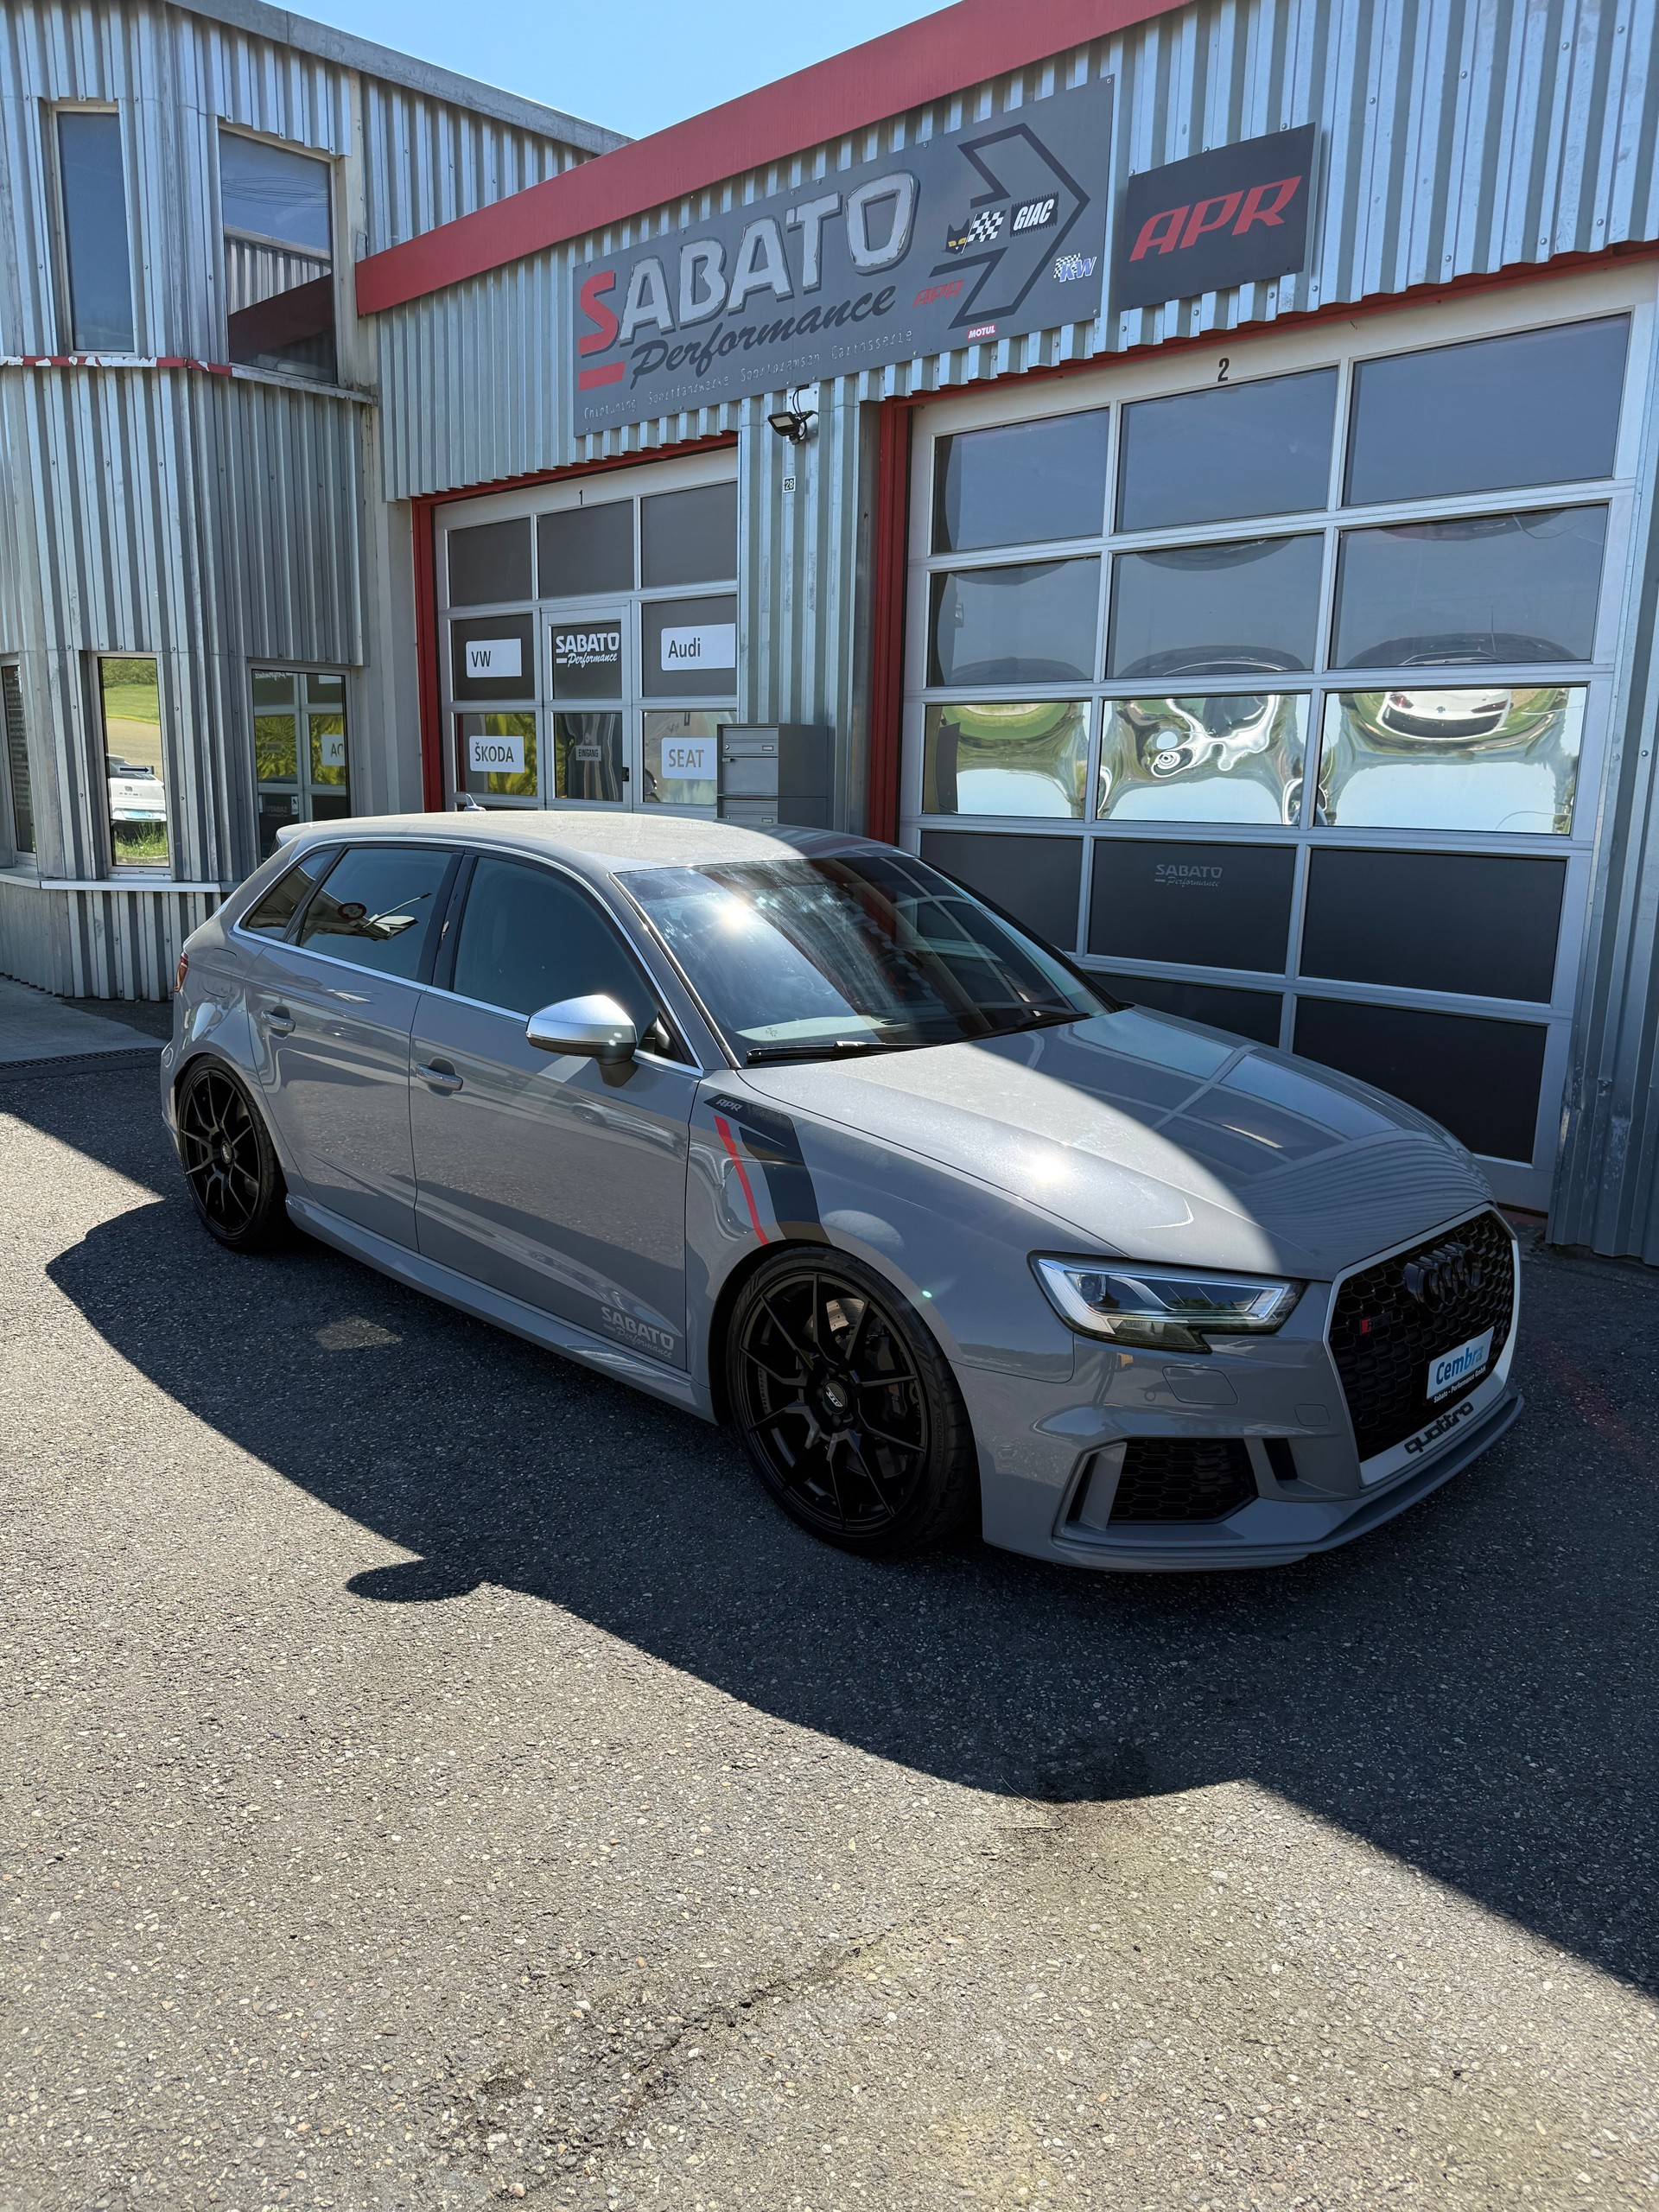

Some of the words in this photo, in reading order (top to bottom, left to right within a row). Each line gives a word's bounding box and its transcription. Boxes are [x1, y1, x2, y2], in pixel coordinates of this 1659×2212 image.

[1013, 199, 1055, 232] GIAC
[1129, 175, 1302, 262] APR
[578, 171, 918, 356] SABATO
[1058, 257, 1096, 283] KW
[912, 279, 963, 307] APR
[630, 285, 896, 390] Performance
[968, 325, 995, 339] MOTUL
[1217, 358, 1230, 381] 2
[785, 480, 793, 490] 28
[578, 489, 584, 505] 1
[556, 632, 620, 653] SABATO
[668, 638, 701, 658] Audi
[471, 651, 492, 667] VW
[568, 652, 618, 668] Performance
[475, 741, 514, 762] ŠKODA
[578, 748, 599, 757] EINGANG
[668, 749, 705, 768] SEAT
[1155, 864, 1223, 878] SABATO
[1166, 875, 1220, 887] Performance
[716, 1098, 743, 1112] APR
[601, 1306, 674, 1351] SABATO
[615, 1327, 672, 1358] Performance
[1435, 1345, 1484, 1385] Cembra
[1404, 1402, 1474, 1454] quattro
